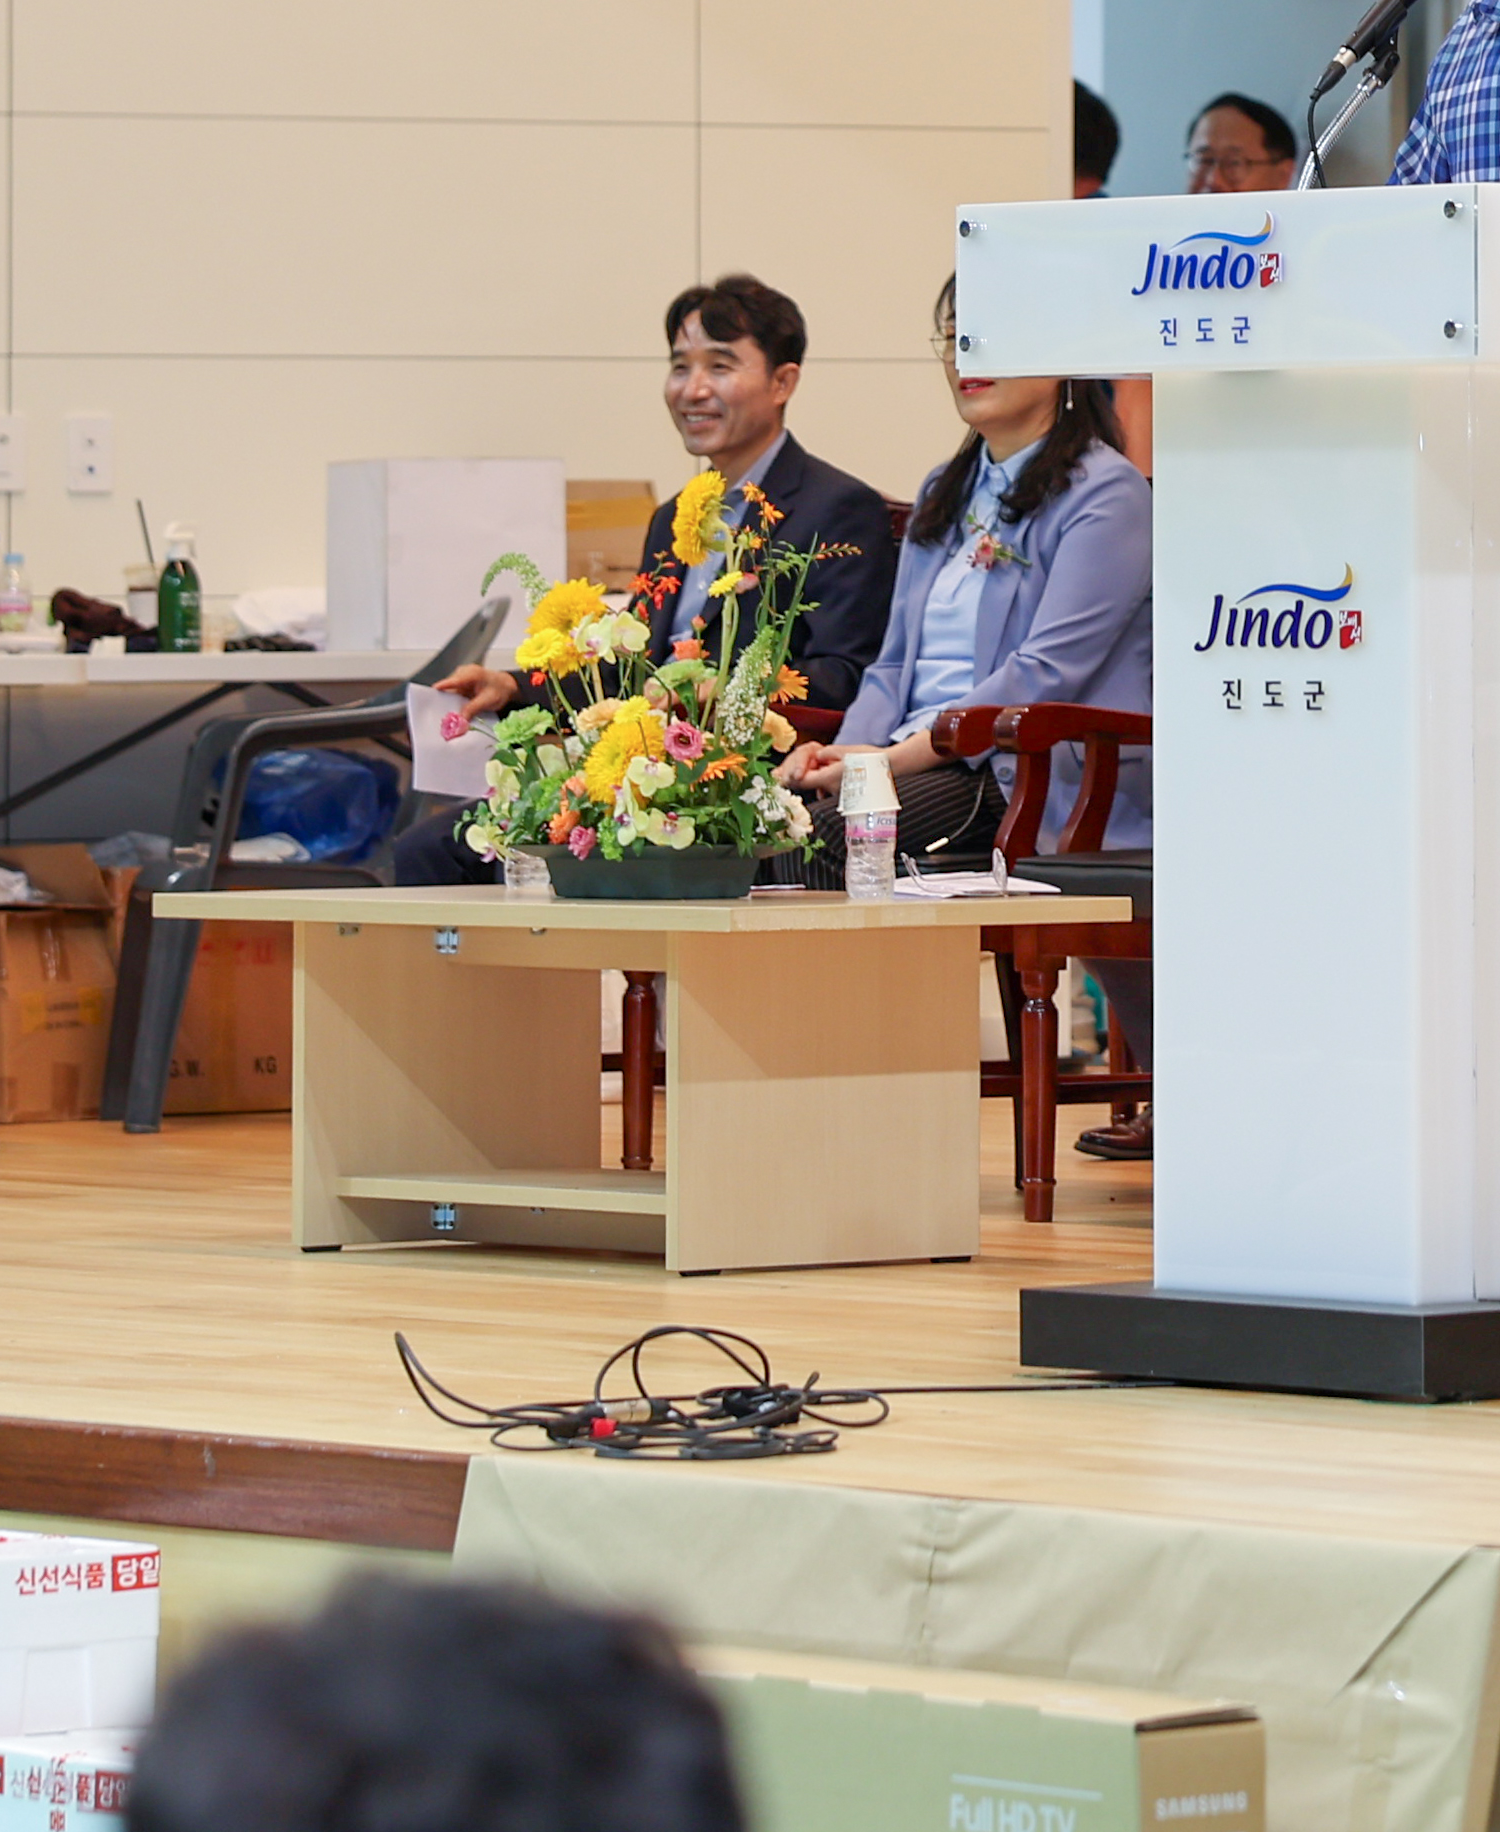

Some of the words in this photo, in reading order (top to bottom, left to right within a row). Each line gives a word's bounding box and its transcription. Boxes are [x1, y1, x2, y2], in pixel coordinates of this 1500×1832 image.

[1131, 243, 1255, 295] Jindo
[1194, 594, 1333, 651] Jindo
[254, 1055, 277, 1075] KG
[16, 1563, 105, 1595] 신선식품
[950, 1794, 994, 1832] Full
[999, 1798, 1037, 1832] HD
[1040, 1803, 1077, 1832] TV
[1156, 1791, 1248, 1821] SAMSUNG
